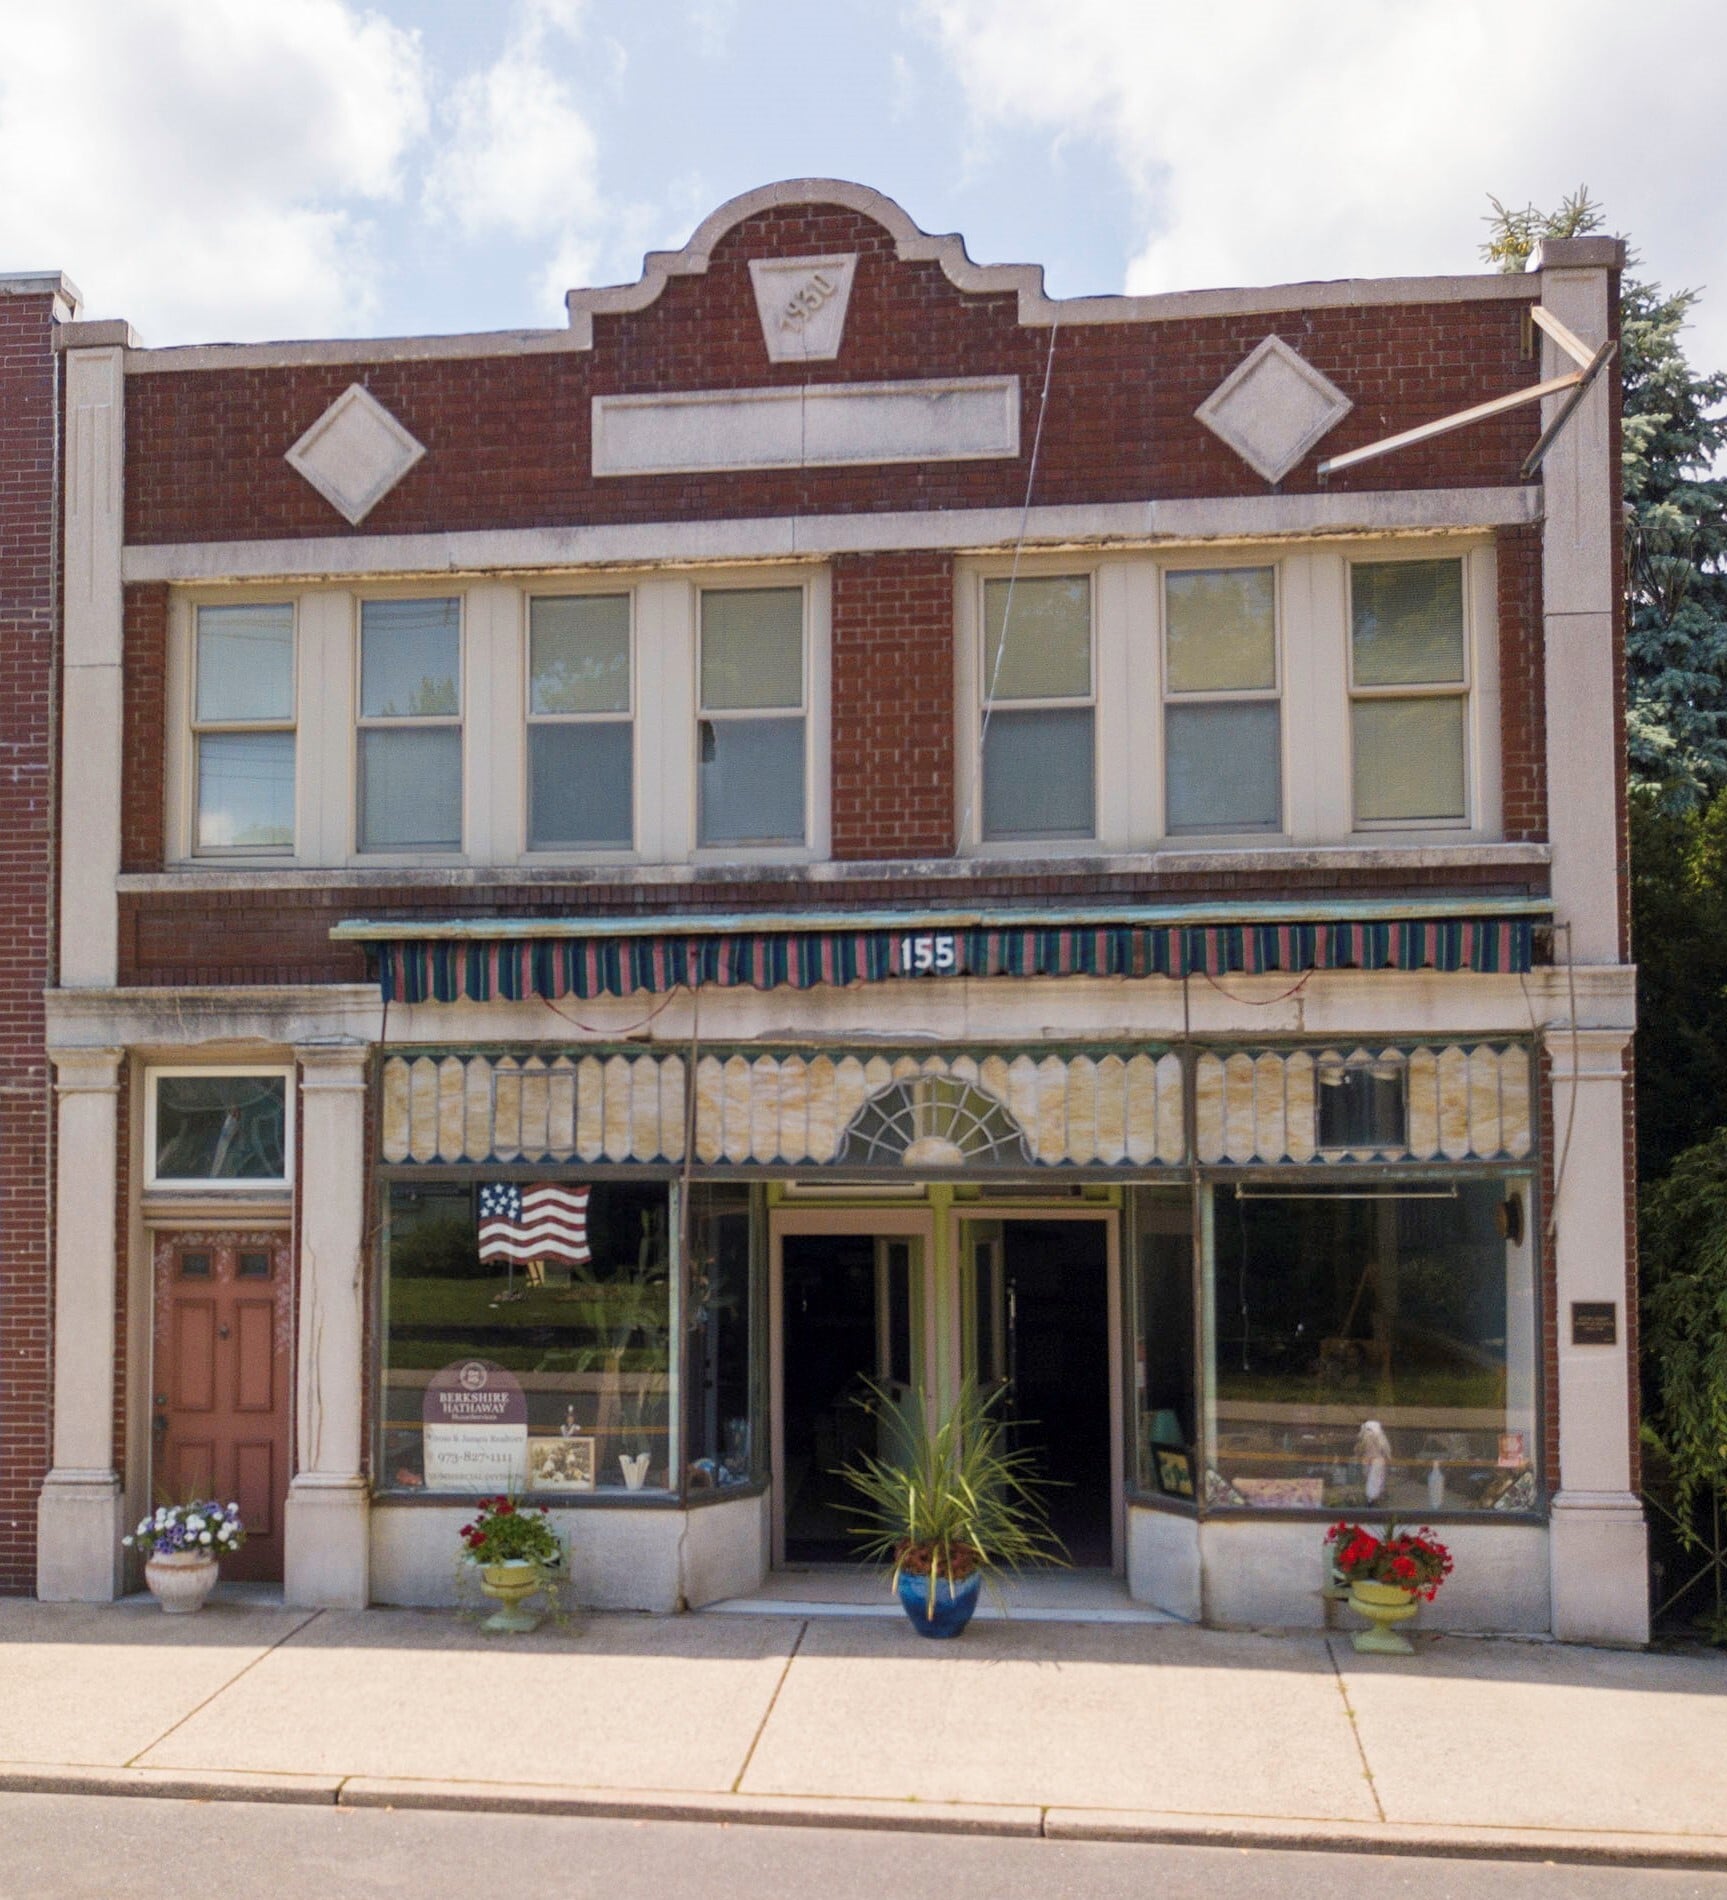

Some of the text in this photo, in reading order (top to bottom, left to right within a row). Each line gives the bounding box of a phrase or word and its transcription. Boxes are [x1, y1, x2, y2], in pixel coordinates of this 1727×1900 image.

[901, 936, 955, 970] 155
[440, 1392, 509, 1403] BERKSHIRE
[443, 1403, 505, 1413] HATHAWAY
[437, 1451, 513, 1464] 973-827-1111
